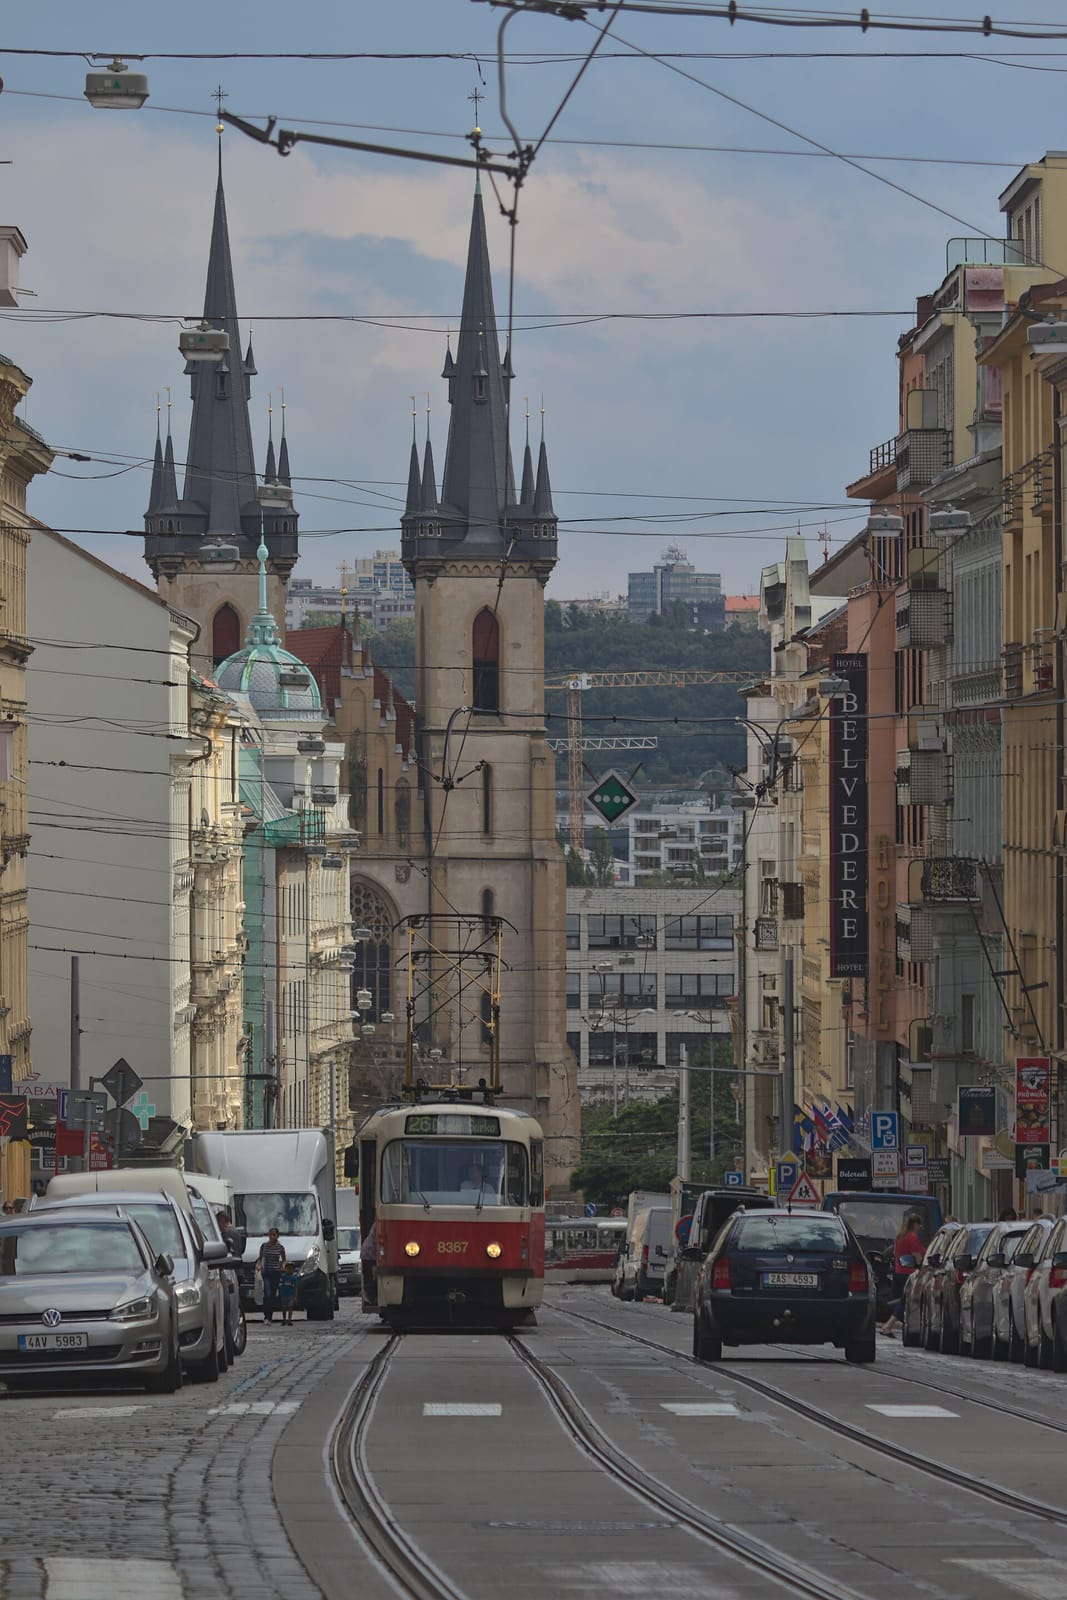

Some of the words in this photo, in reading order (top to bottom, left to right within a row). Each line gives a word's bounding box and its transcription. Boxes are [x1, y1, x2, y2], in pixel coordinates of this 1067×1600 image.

[836, 658, 863, 668] HOTEL
[840, 692, 859, 939] BELVEDERE
[837, 963, 864, 972] HOTEL
[409, 1116, 431, 1132] 26
[876, 1115, 892, 1139] P
[780, 1165, 793, 1183] P
[437, 1240, 469, 1254] 8367
[770, 1274, 787, 1284] 2AS
[793, 1273, 814, 1284] 4593
[28, 1337, 47, 1348] 4AV
[55, 1336, 82, 1347] 5983
